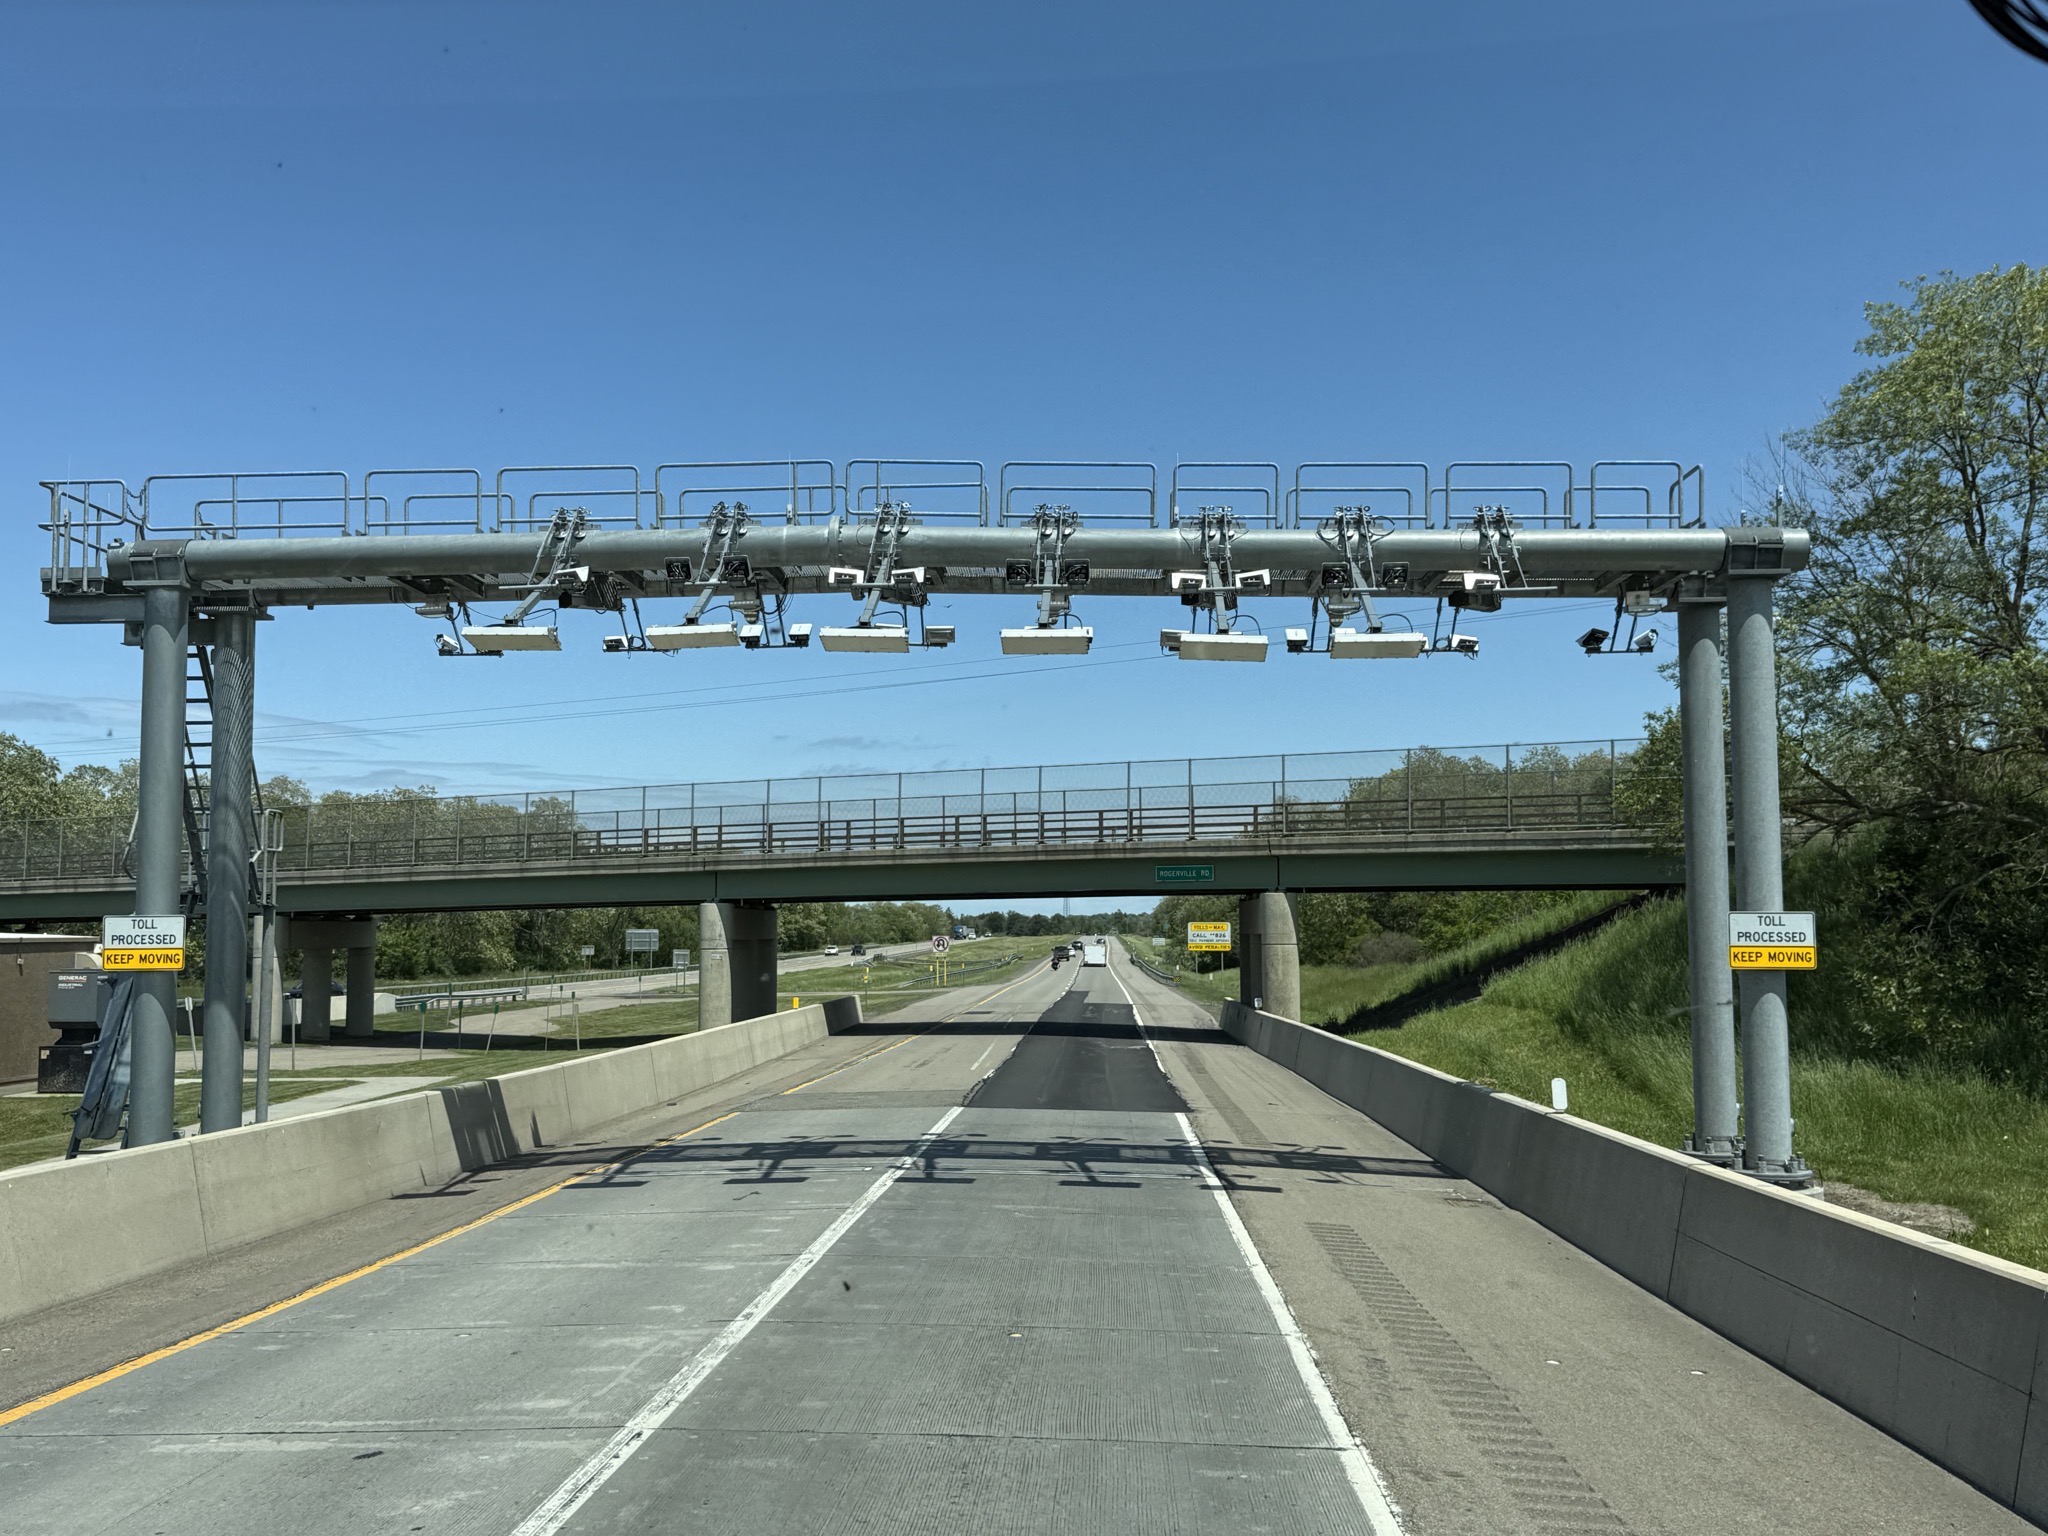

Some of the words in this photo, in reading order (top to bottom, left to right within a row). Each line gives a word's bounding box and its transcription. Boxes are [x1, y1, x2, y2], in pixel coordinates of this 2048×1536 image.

[131, 919, 158, 930] TOLL
[1757, 915, 1786, 927] TOLL
[111, 934, 177, 945] PROCESSED
[1737, 931, 1807, 943] PROCESSED
[106, 954, 134, 964] KEEP
[139, 953, 180, 964] MOVING
[1733, 951, 1763, 963] KEEP
[1768, 951, 1812, 963] MOVING
